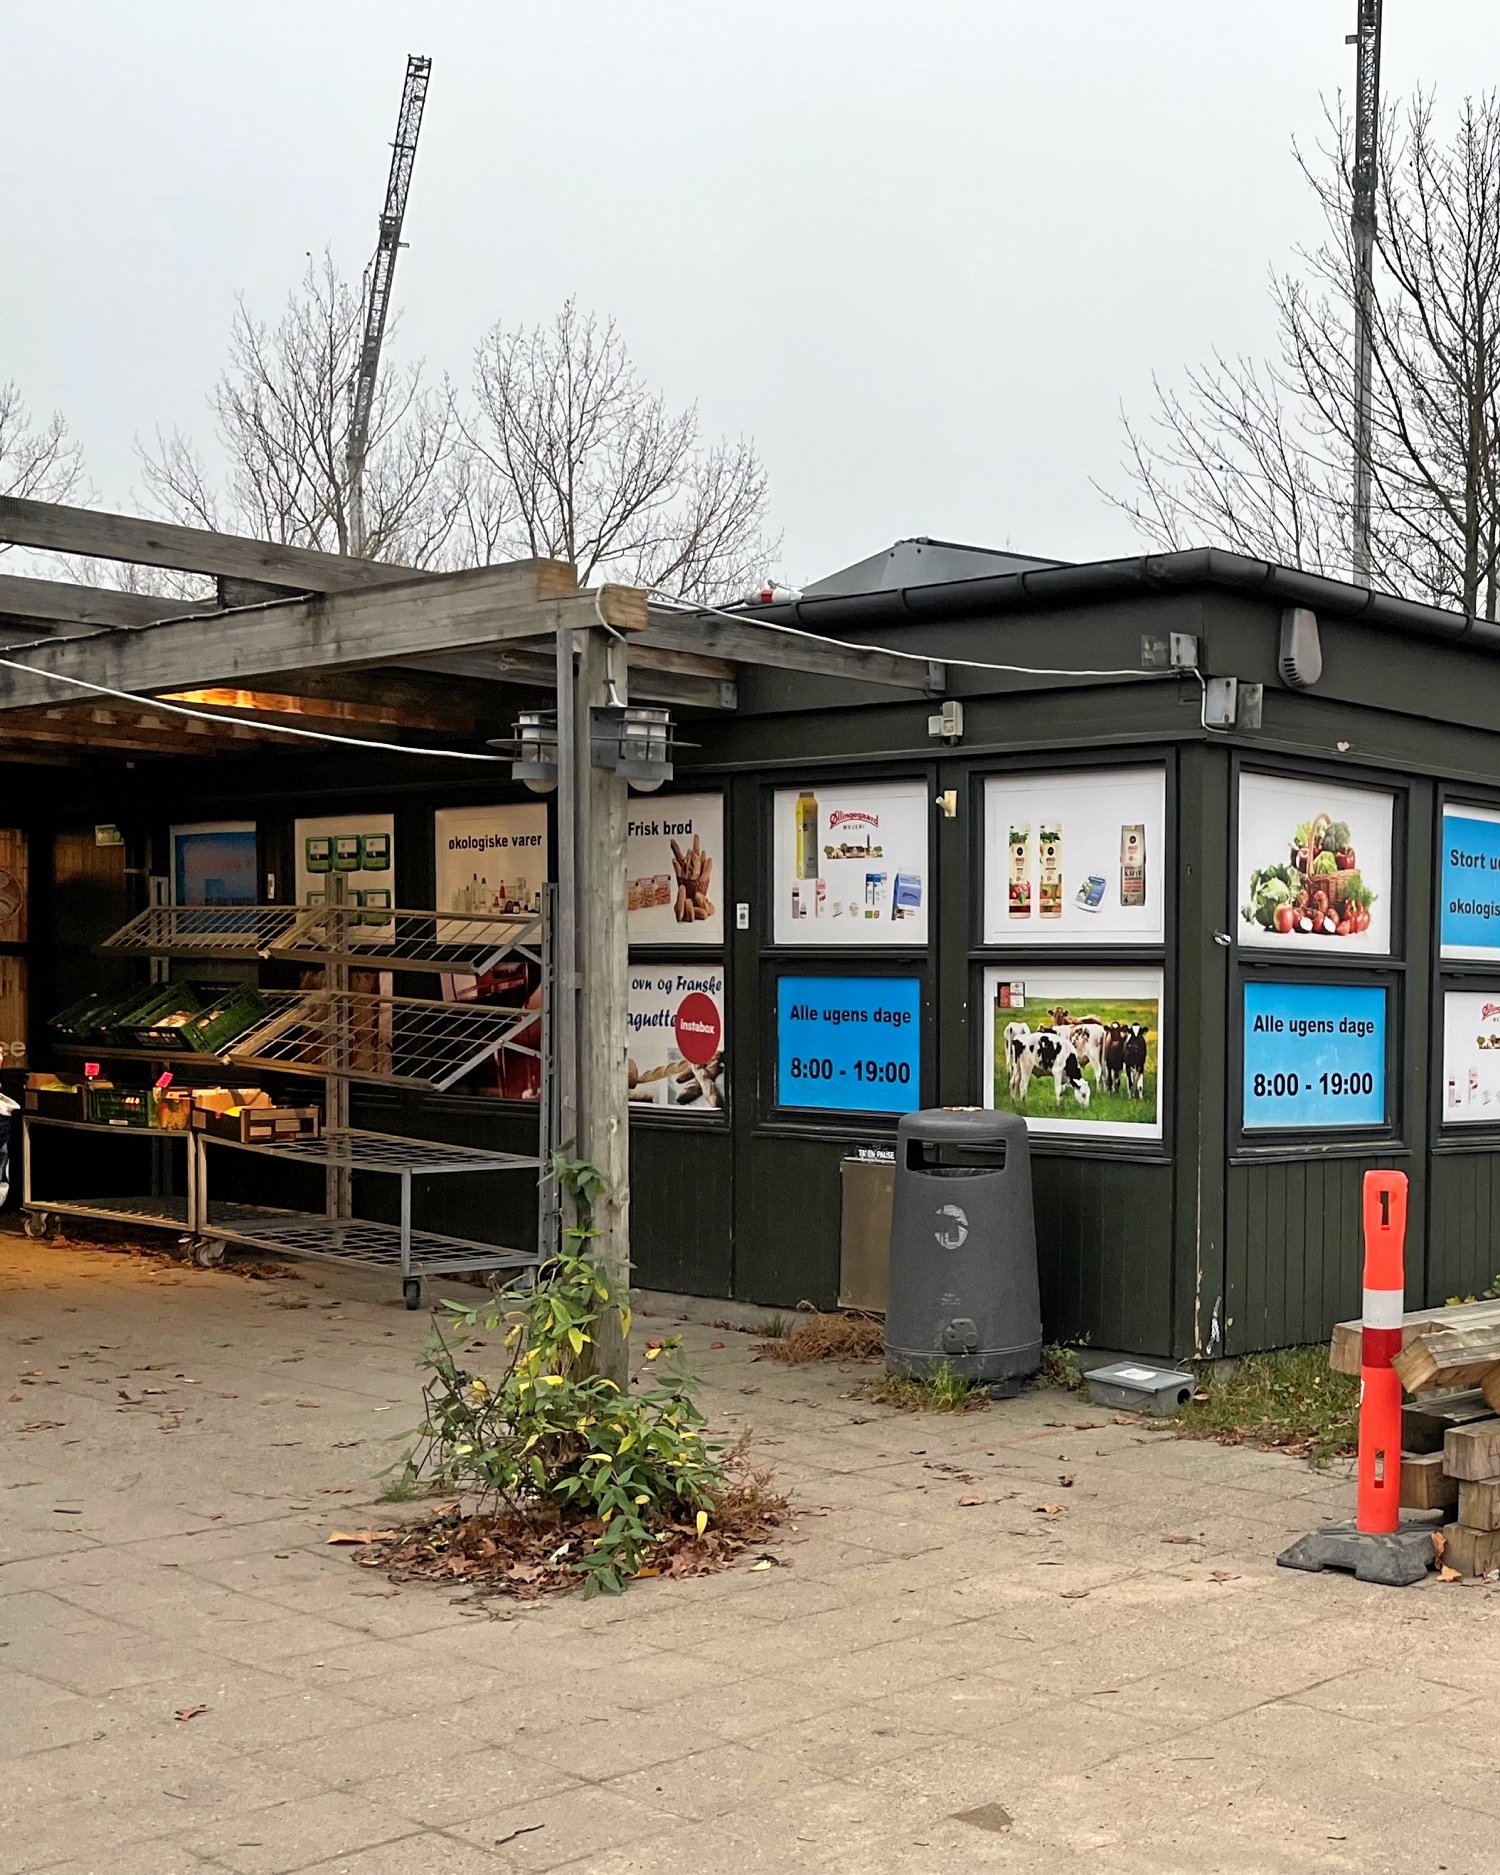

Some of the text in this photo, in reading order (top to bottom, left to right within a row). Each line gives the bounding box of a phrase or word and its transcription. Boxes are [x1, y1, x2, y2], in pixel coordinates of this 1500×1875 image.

[628, 819, 692, 836] Frisk brød
[449, 834, 542, 851] økologiske varer
[1450, 849, 1485, 869] Stort
[632, 976, 721, 994] ovn og Franske
[790, 1005, 911, 1027] Alle ugens dage
[1253, 1015, 1374, 1037] Alle ugens dage
[681, 1019, 715, 1034] instabox
[791, 1057, 833, 1080] 8:00
[853, 1060, 910, 1084] 19:00
[1253, 1073, 1299, 1096] 8:00
[1319, 1072, 1373, 1095] 19:00
